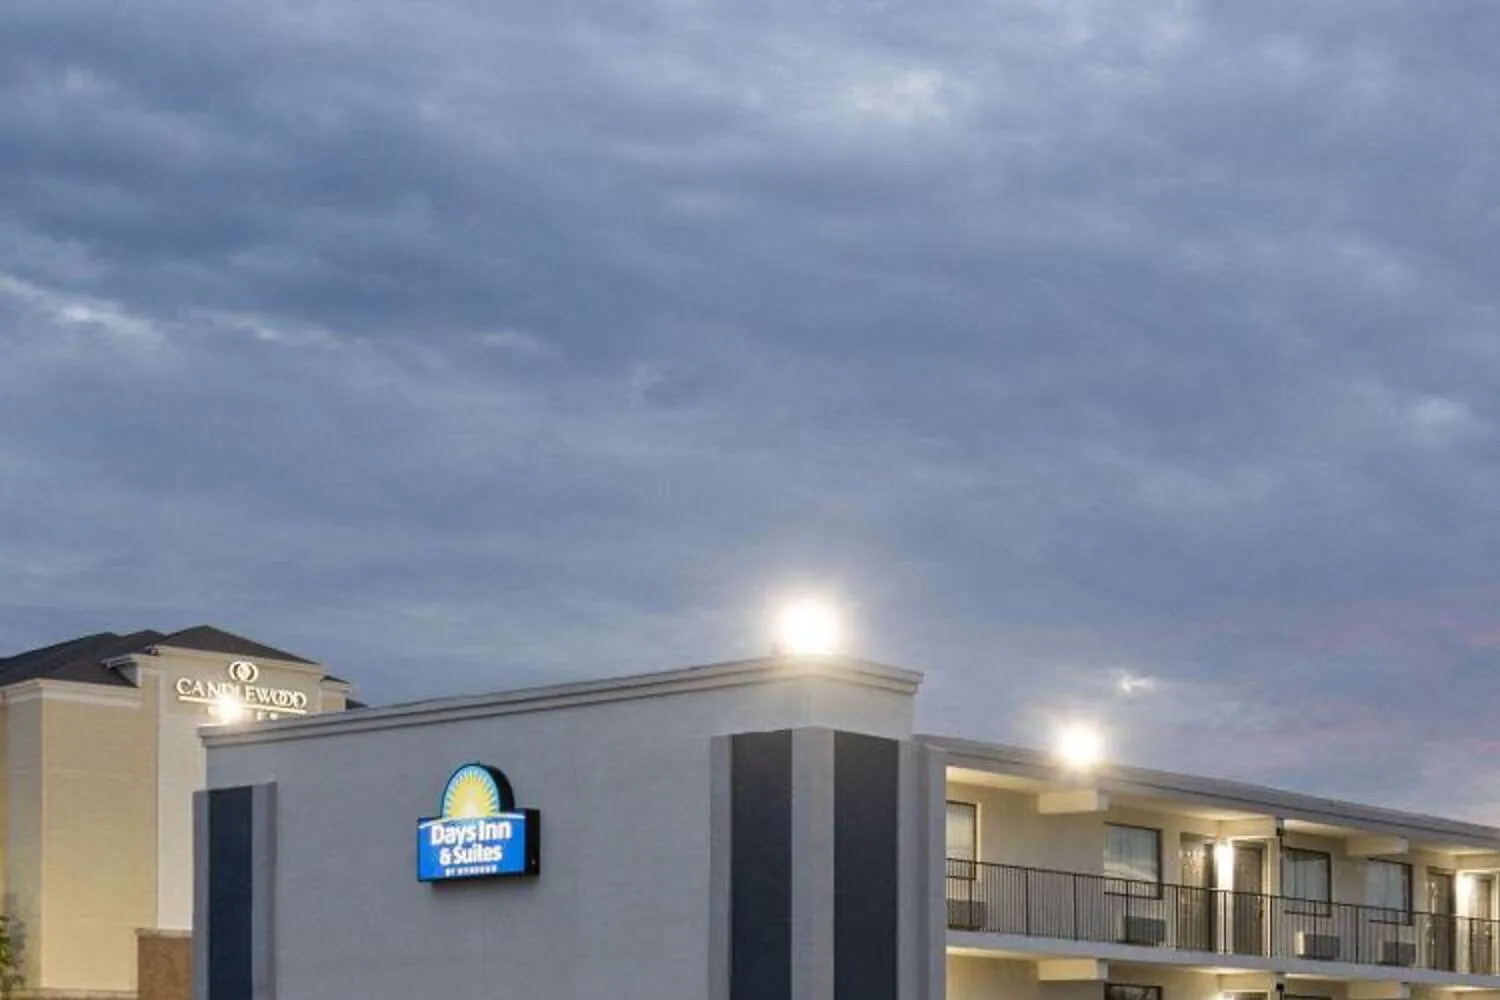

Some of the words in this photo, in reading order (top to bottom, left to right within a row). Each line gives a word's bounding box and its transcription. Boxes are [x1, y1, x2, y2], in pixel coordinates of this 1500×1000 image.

[431, 824, 476, 846] Days
[479, 820, 512, 841] Inn
[453, 843, 503, 864] Suites
